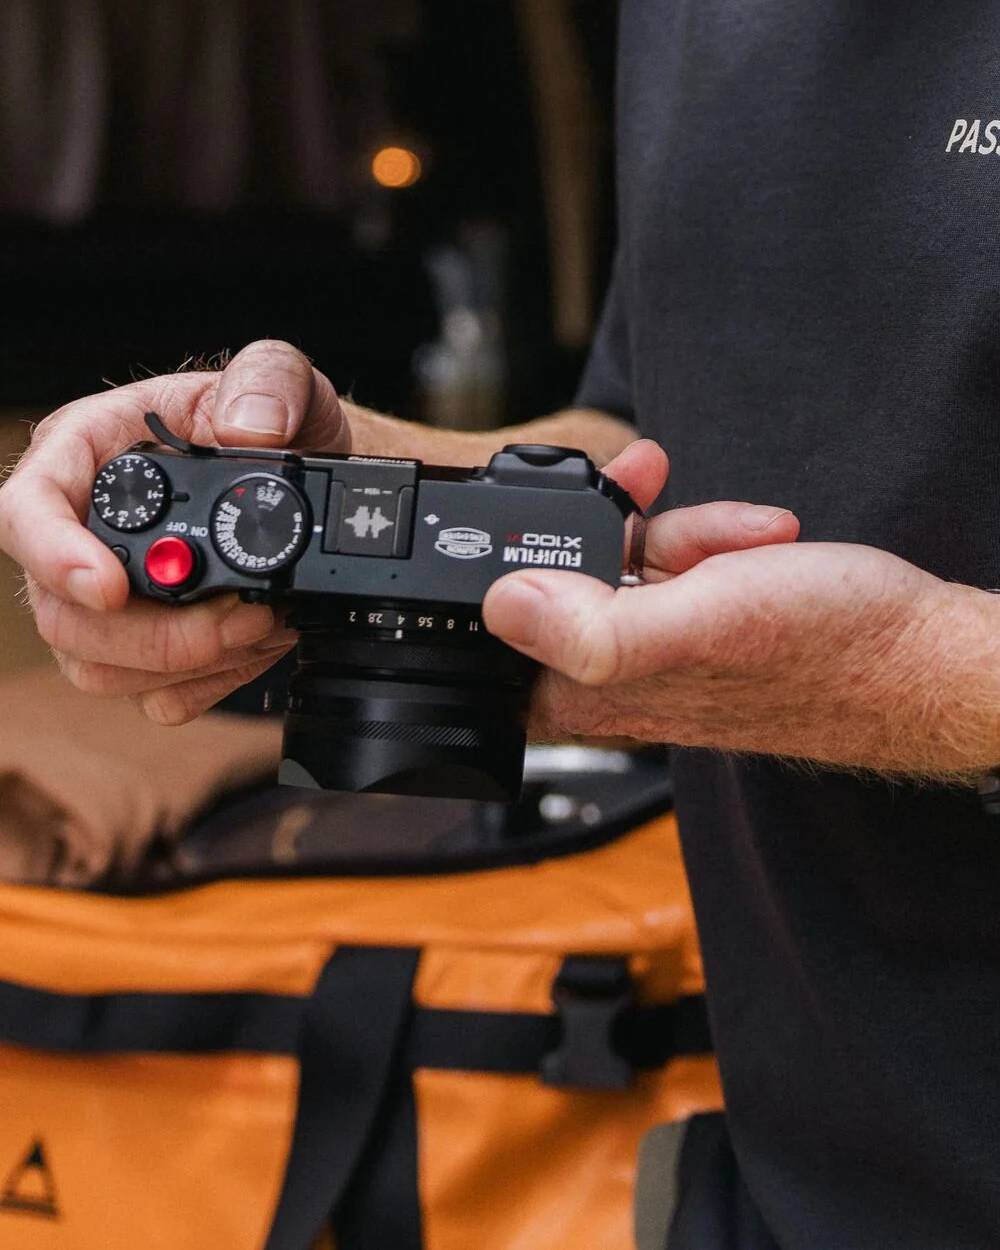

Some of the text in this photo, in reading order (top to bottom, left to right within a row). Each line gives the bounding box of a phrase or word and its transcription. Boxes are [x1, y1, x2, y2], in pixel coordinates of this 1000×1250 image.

[166, 521, 187, 533] OFF
[190, 526, 208, 537] ON
[503, 546, 582, 567] FUJIFILM
